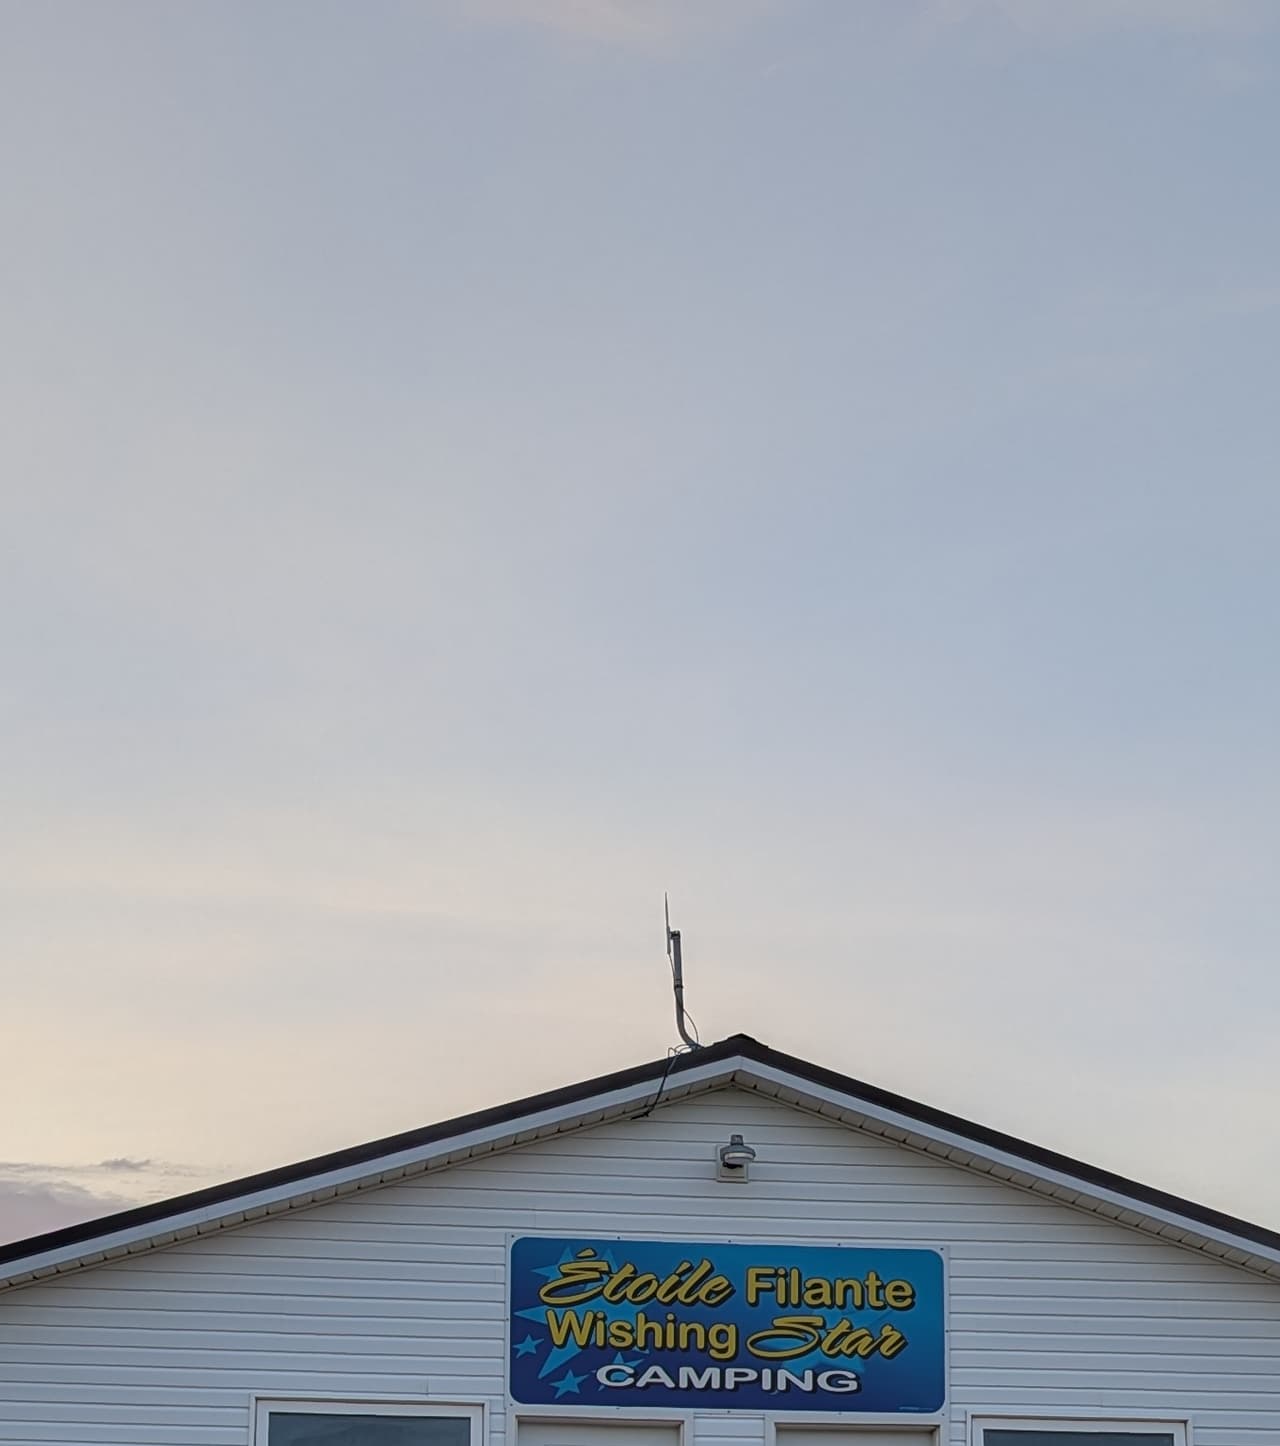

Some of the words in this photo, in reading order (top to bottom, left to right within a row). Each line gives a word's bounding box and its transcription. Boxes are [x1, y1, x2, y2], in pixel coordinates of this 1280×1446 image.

[539, 1248, 734, 1306] Étoile
[746, 1266, 915, 1309] Filante
[546, 1309, 738, 1360] Wishing
[746, 1315, 907, 1360] Star
[596, 1364, 860, 1393] CAMPING
